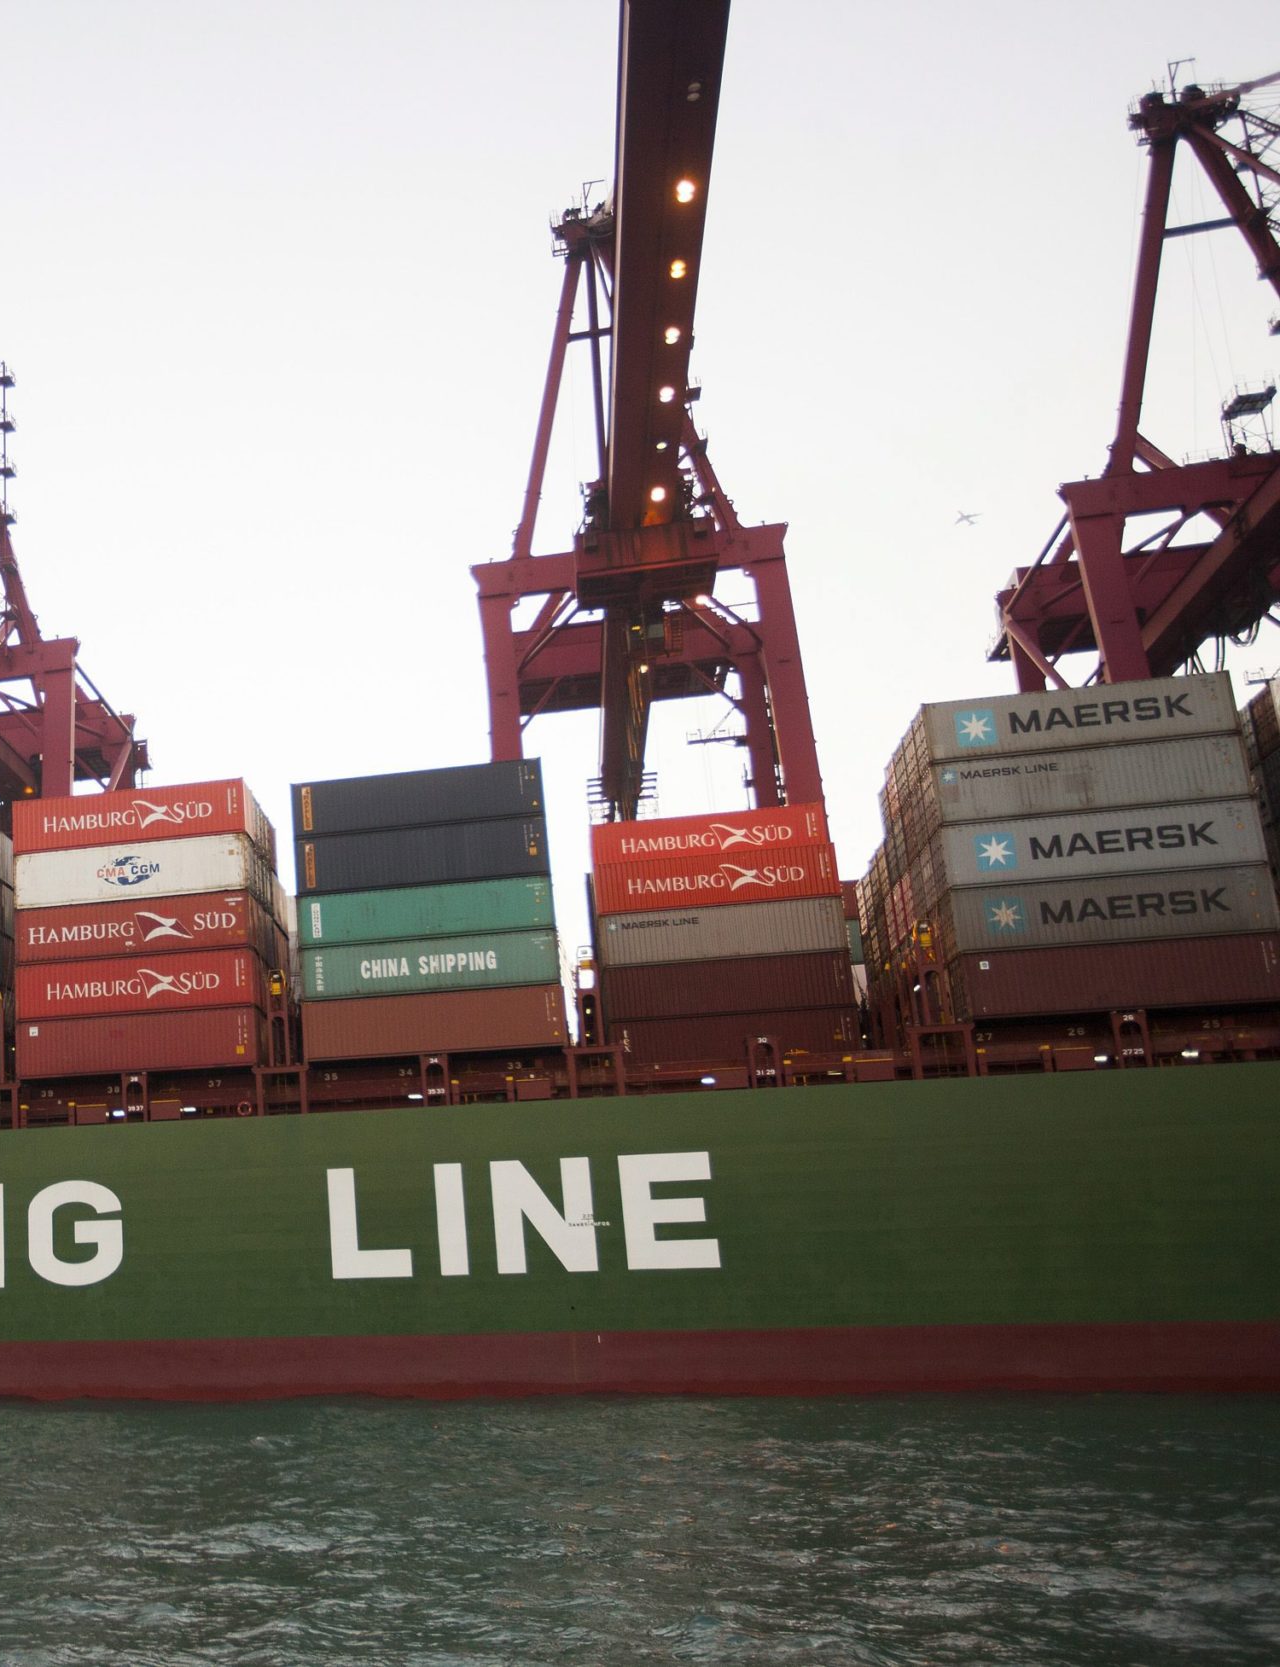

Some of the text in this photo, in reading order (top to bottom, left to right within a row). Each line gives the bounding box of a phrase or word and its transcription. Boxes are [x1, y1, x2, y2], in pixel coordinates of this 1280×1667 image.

[1008, 693, 1194, 735] MAERSK
[960, 762, 1059, 780] MAERSK LINE
[43, 801, 212, 833] HAMBURG SÜD
[621, 825, 792, 854] HAMBURG SÜD
[1029, 821, 1218, 860] MAERSK
[97, 864, 160, 879] CMA CGM
[627, 865, 804, 895] HAMBURG SÜD
[1040, 887, 1232, 926] MAERSK
[29, 912, 236, 945] HAMBURG SÜD
[622, 917, 700, 930] MAERSK LINE
[360, 950, 498, 980] CHINA SHIPPING
[47, 971, 220, 1001] HAMBURG SÜD
[1067, 1027, 1085, 1037] 26
[1202, 1019, 1220, 1029] 25
[976, 1032, 993, 1042] 27
[324, 1073, 338, 1081] 35
[399, 1069, 413, 1077] 34
[507, 1062, 522, 1070] 33
[208, 1080, 221, 1088] 37
[326, 1151, 722, 1279] LINE
